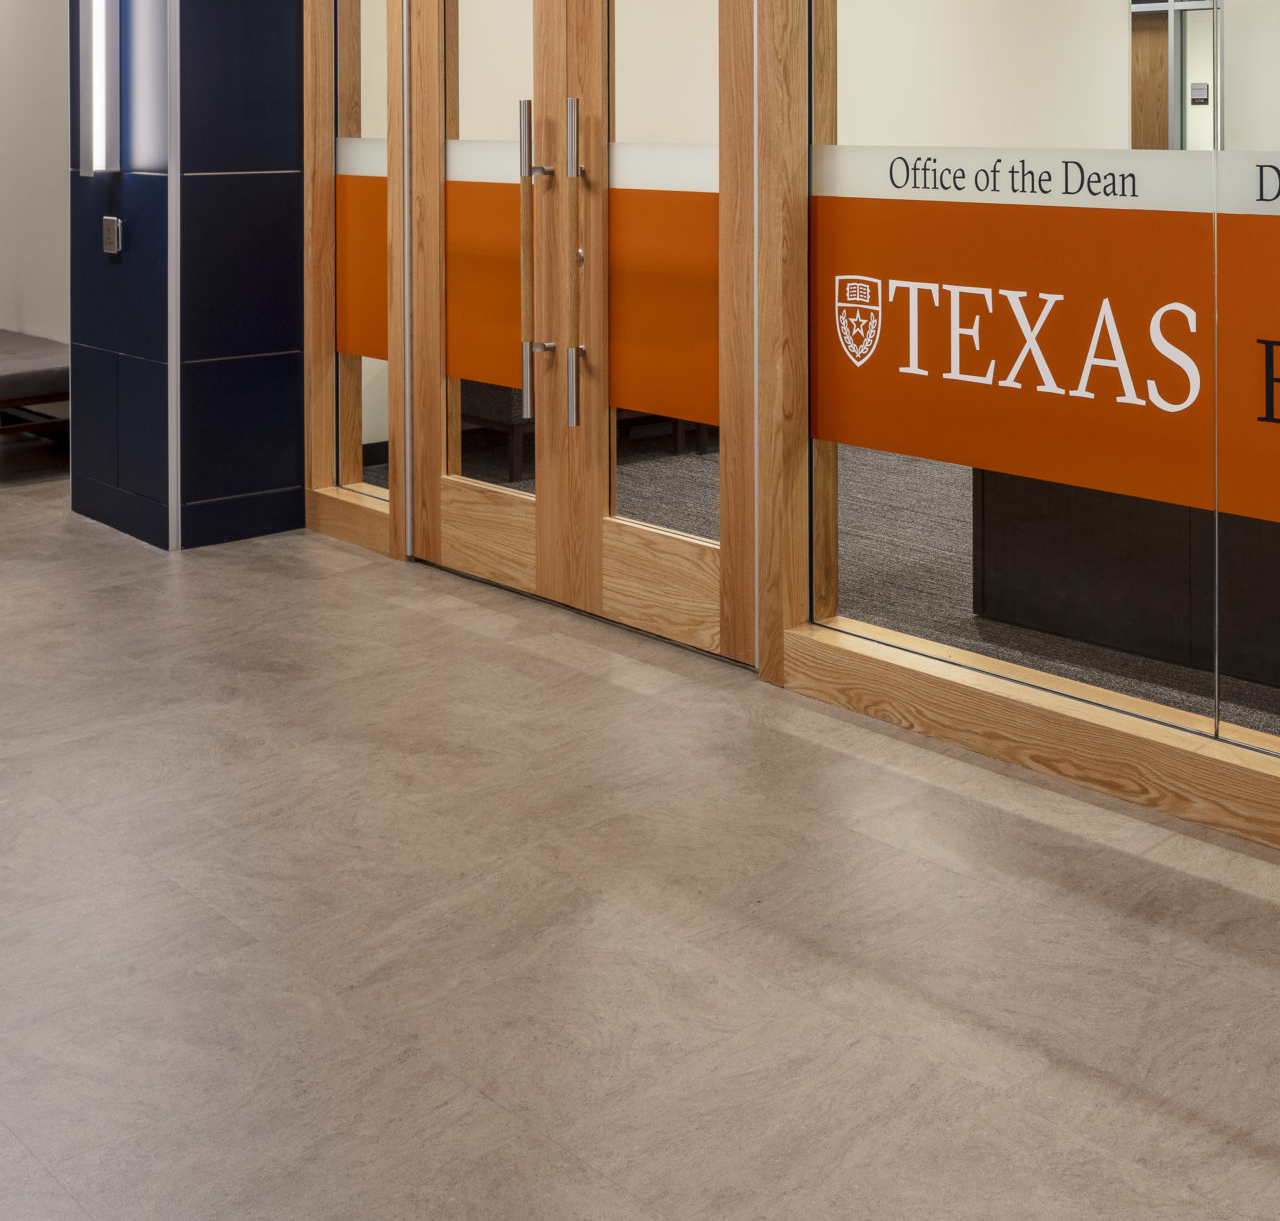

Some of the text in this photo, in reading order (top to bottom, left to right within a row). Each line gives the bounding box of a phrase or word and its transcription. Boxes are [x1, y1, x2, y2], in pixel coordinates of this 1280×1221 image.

[888, 156, 1139, 198] Office of the Dean
[888, 279, 1201, 413] TEXAS
